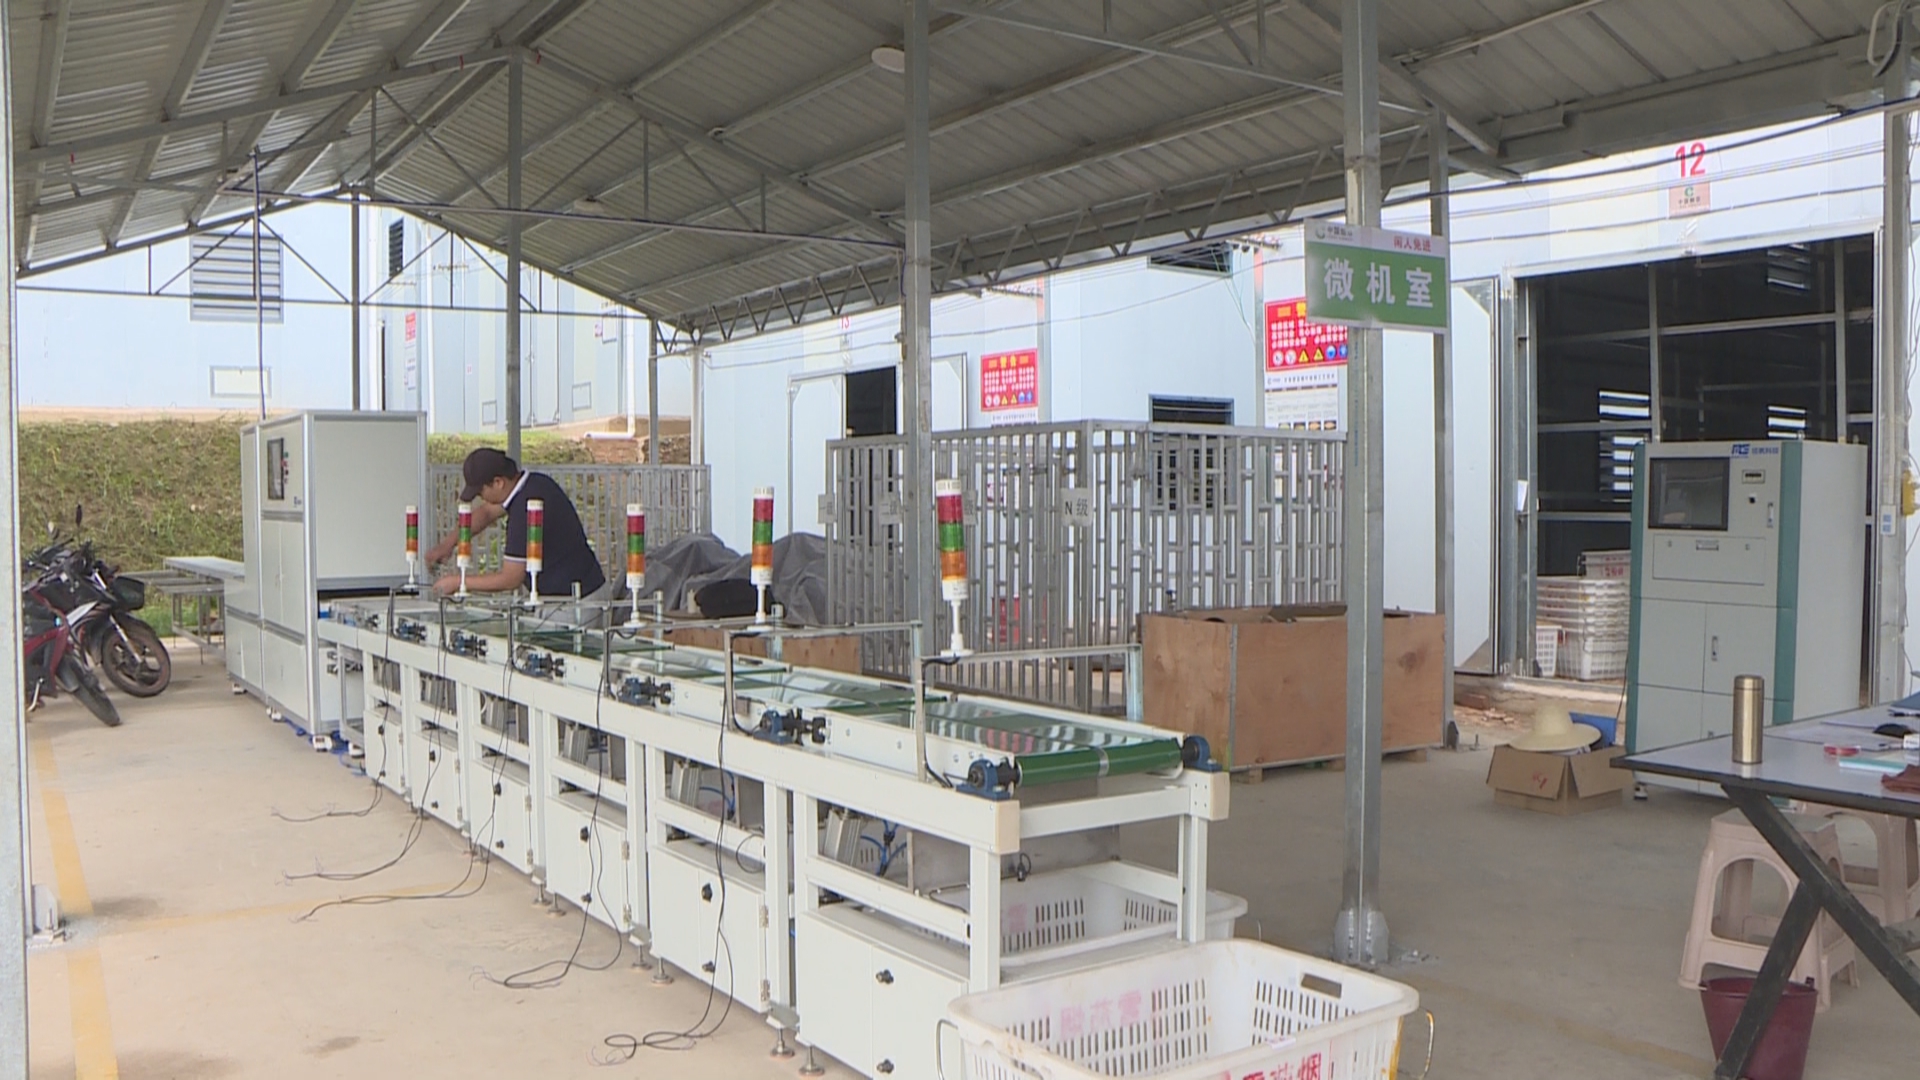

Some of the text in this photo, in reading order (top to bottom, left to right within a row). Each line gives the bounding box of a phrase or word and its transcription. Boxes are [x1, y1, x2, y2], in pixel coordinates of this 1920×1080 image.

[1675, 142, 1706, 179] 12
[1393, 236, 1432, 252] 闲人免进
[1323, 257, 1434, 308] 微机室
